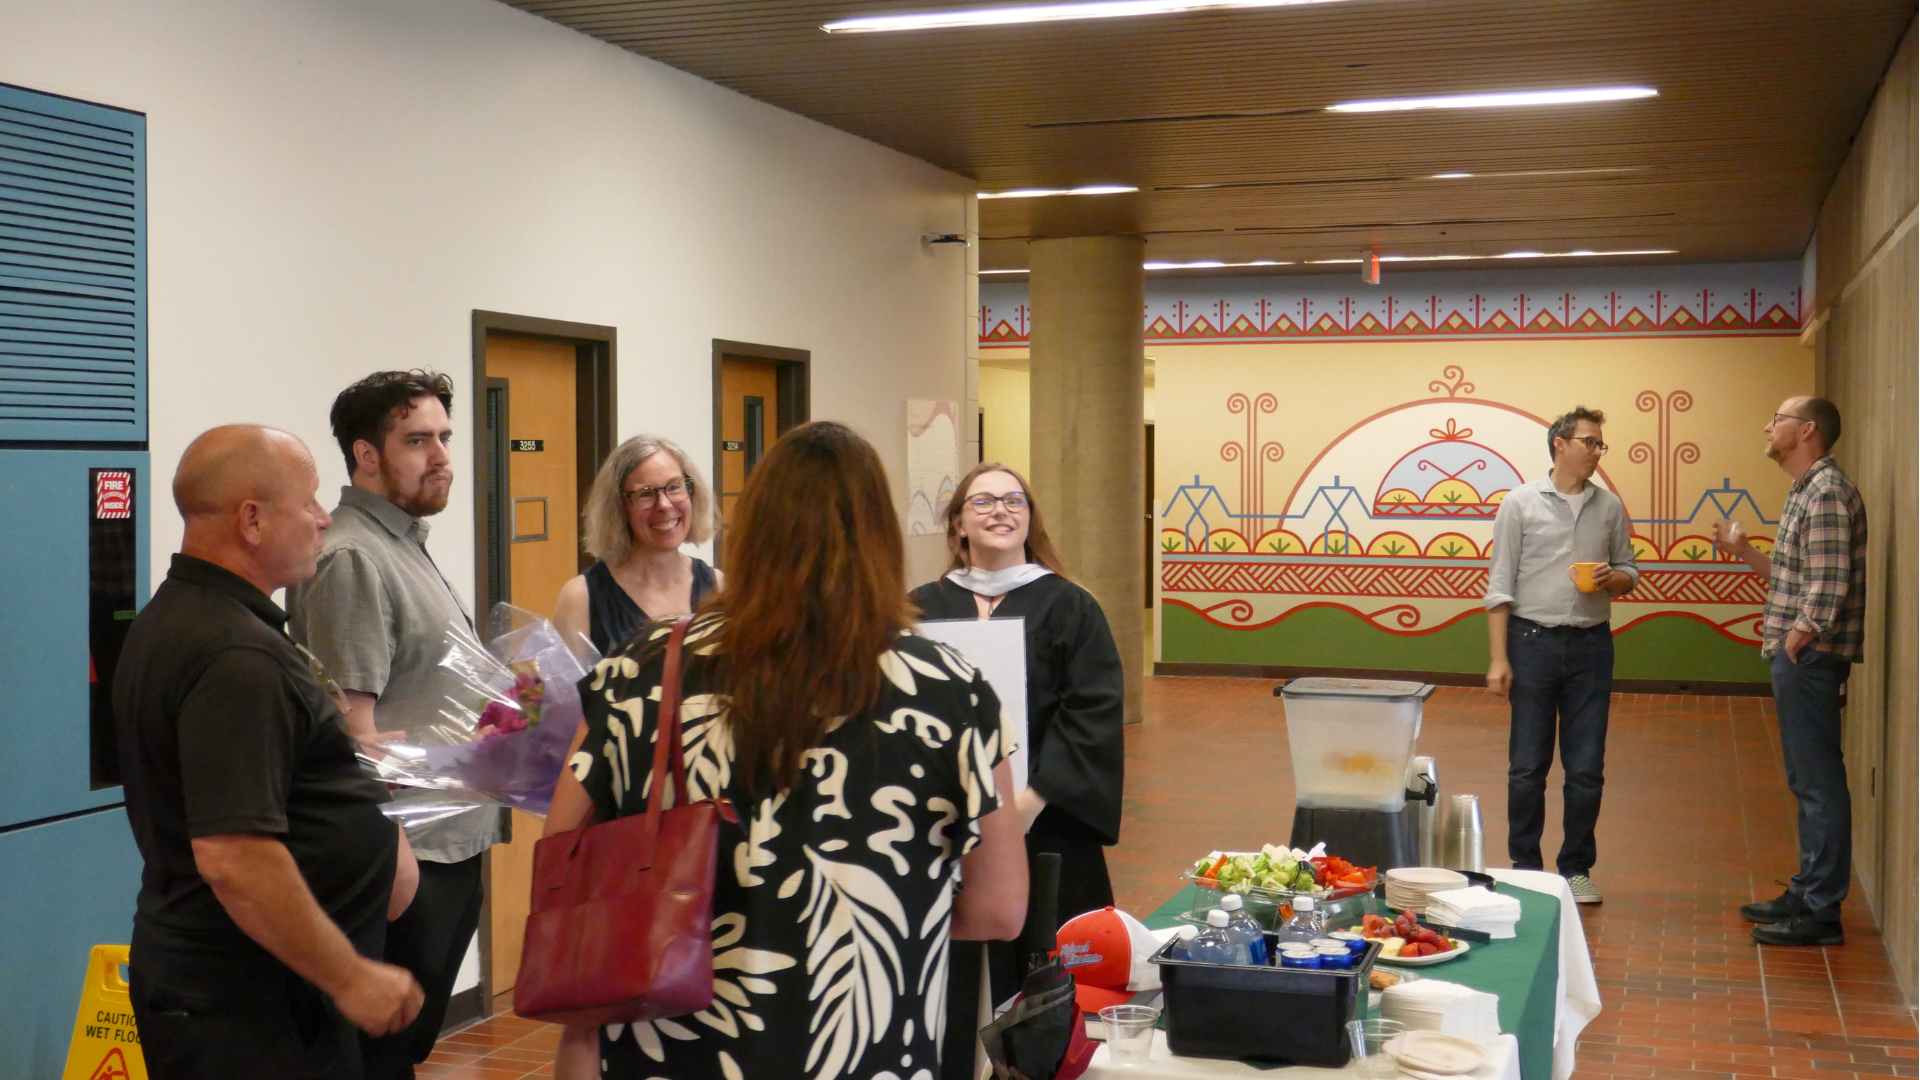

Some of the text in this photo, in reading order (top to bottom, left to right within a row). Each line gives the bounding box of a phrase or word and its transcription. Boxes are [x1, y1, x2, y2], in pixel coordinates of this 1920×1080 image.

[519, 440, 535, 450] 3255
[104, 480, 124, 490] FIRE
[96, 1010, 137, 1027] CAUTIO
[86, 1025, 141, 1044] WET FLOO
